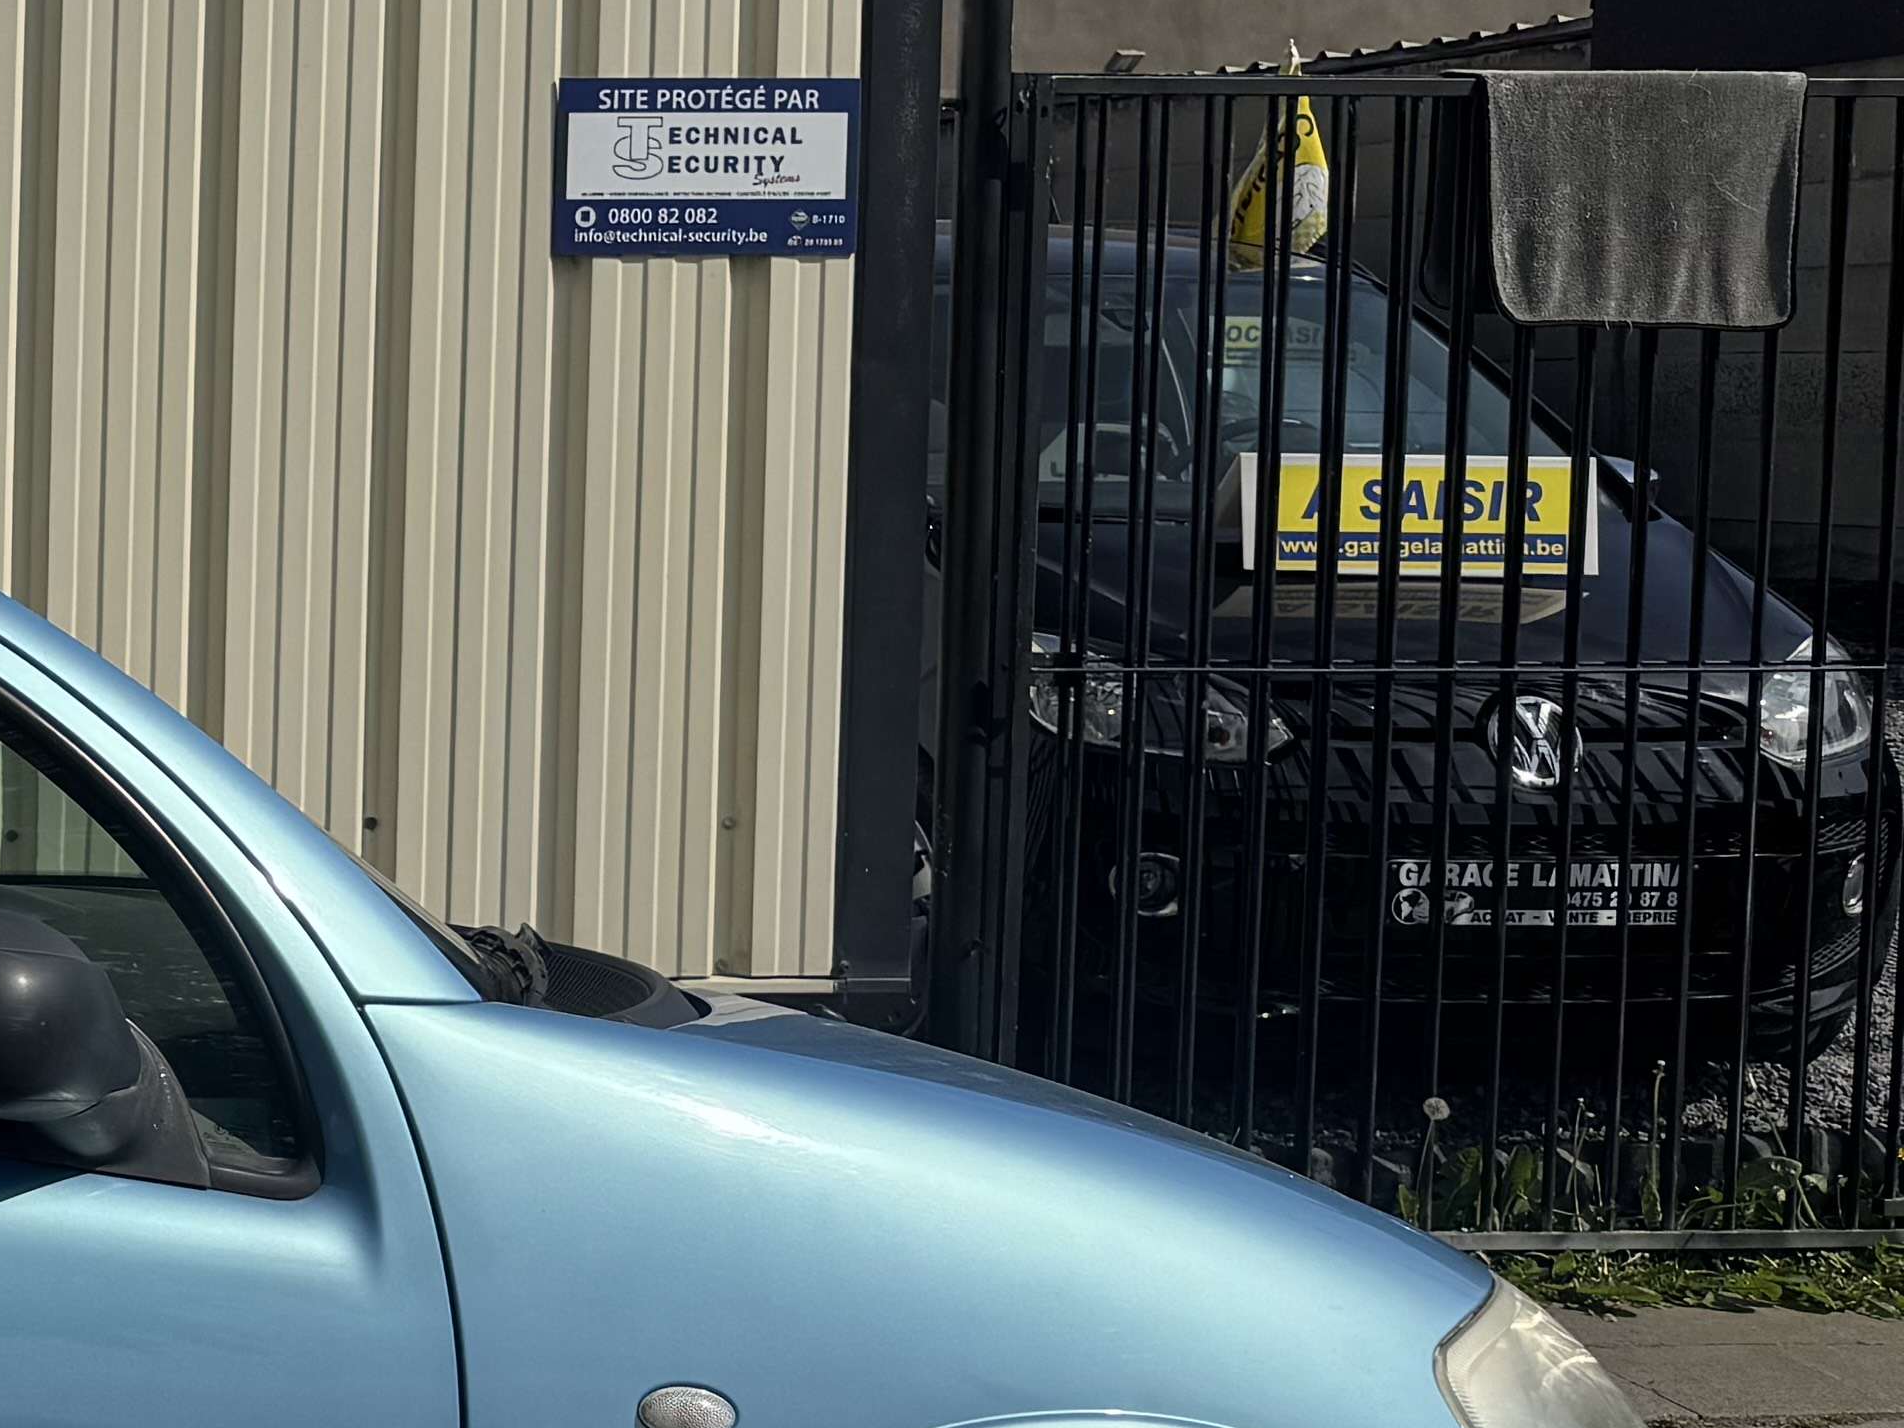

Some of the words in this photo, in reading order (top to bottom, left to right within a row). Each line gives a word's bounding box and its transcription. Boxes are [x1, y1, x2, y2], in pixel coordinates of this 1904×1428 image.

[598, 88, 649, 110] SITE
[656, 84, 766, 110] PROTÉGÉ
[774, 89, 820, 110] PAR
[752, 173, 801, 187] Systems
[607, 207, 652, 225] 0800
[658, 207, 680, 225] 82
[684, 207, 718, 225] 082
[574, 228, 768, 244] info@technical-security.be
